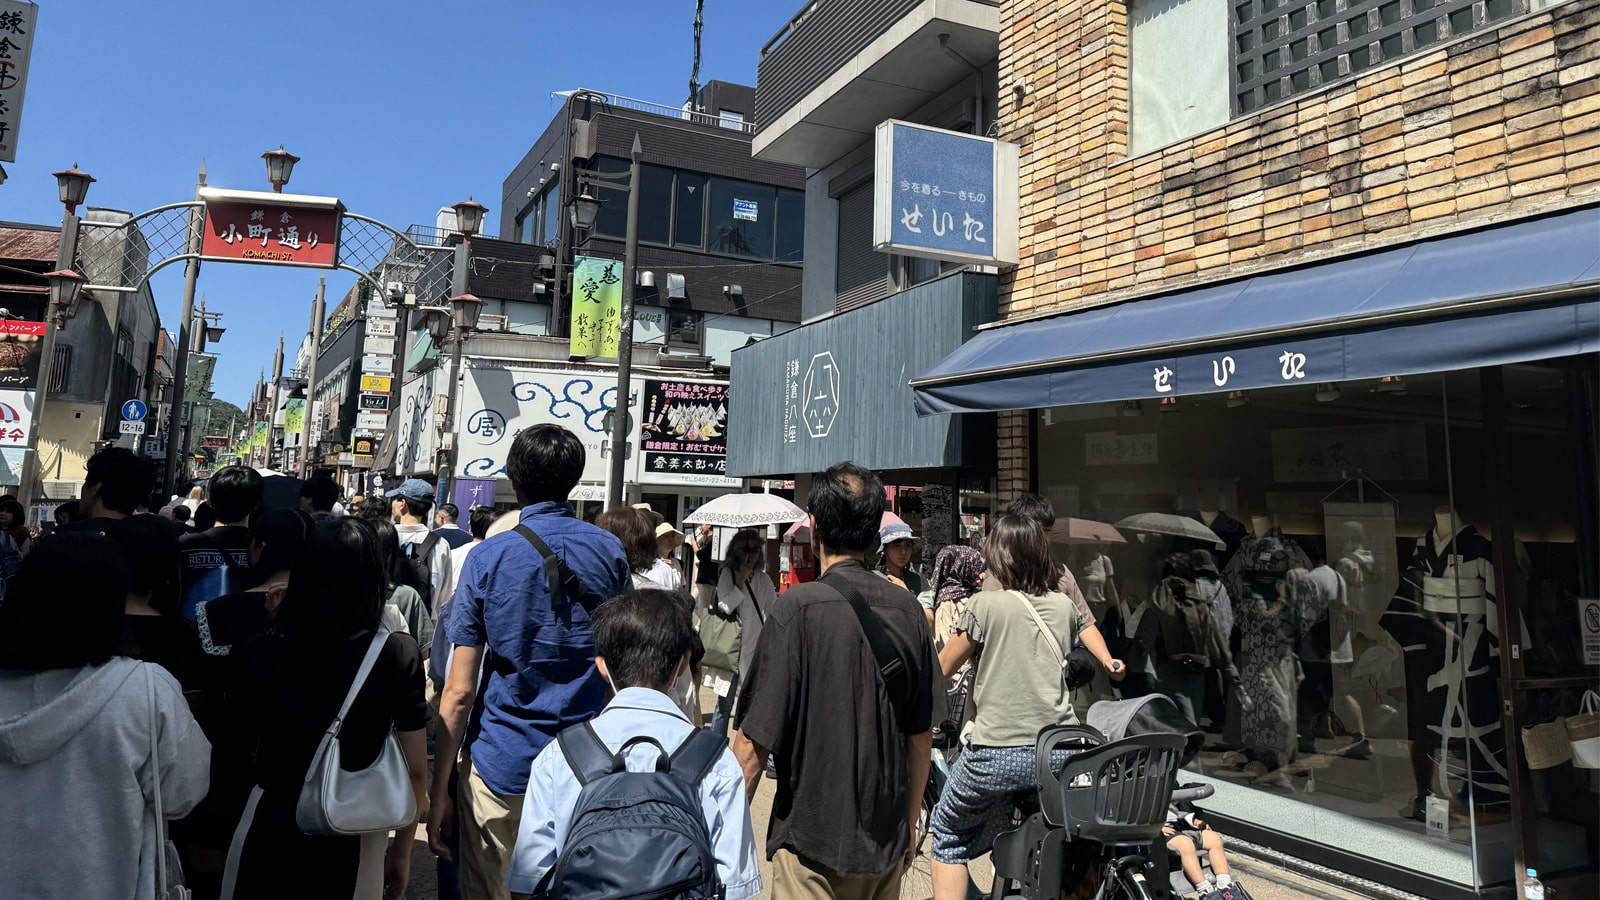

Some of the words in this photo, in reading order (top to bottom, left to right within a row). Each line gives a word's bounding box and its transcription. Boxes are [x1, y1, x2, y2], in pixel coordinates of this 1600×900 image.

[250, 209, 294, 224] 鎌倉
[901, 203, 986, 242] せいた
[221, 223, 319, 249] 小町通り
[242, 249, 281, 260] KOMACHI
[281, 252, 293, 261] ST.
[0, 376, 29, 385] バーグ
[788, 358, 799, 443] 鎌倉八座
[121, 423, 143, 432] 12-16
[653, 456, 726, 471] 登美太郎の店
